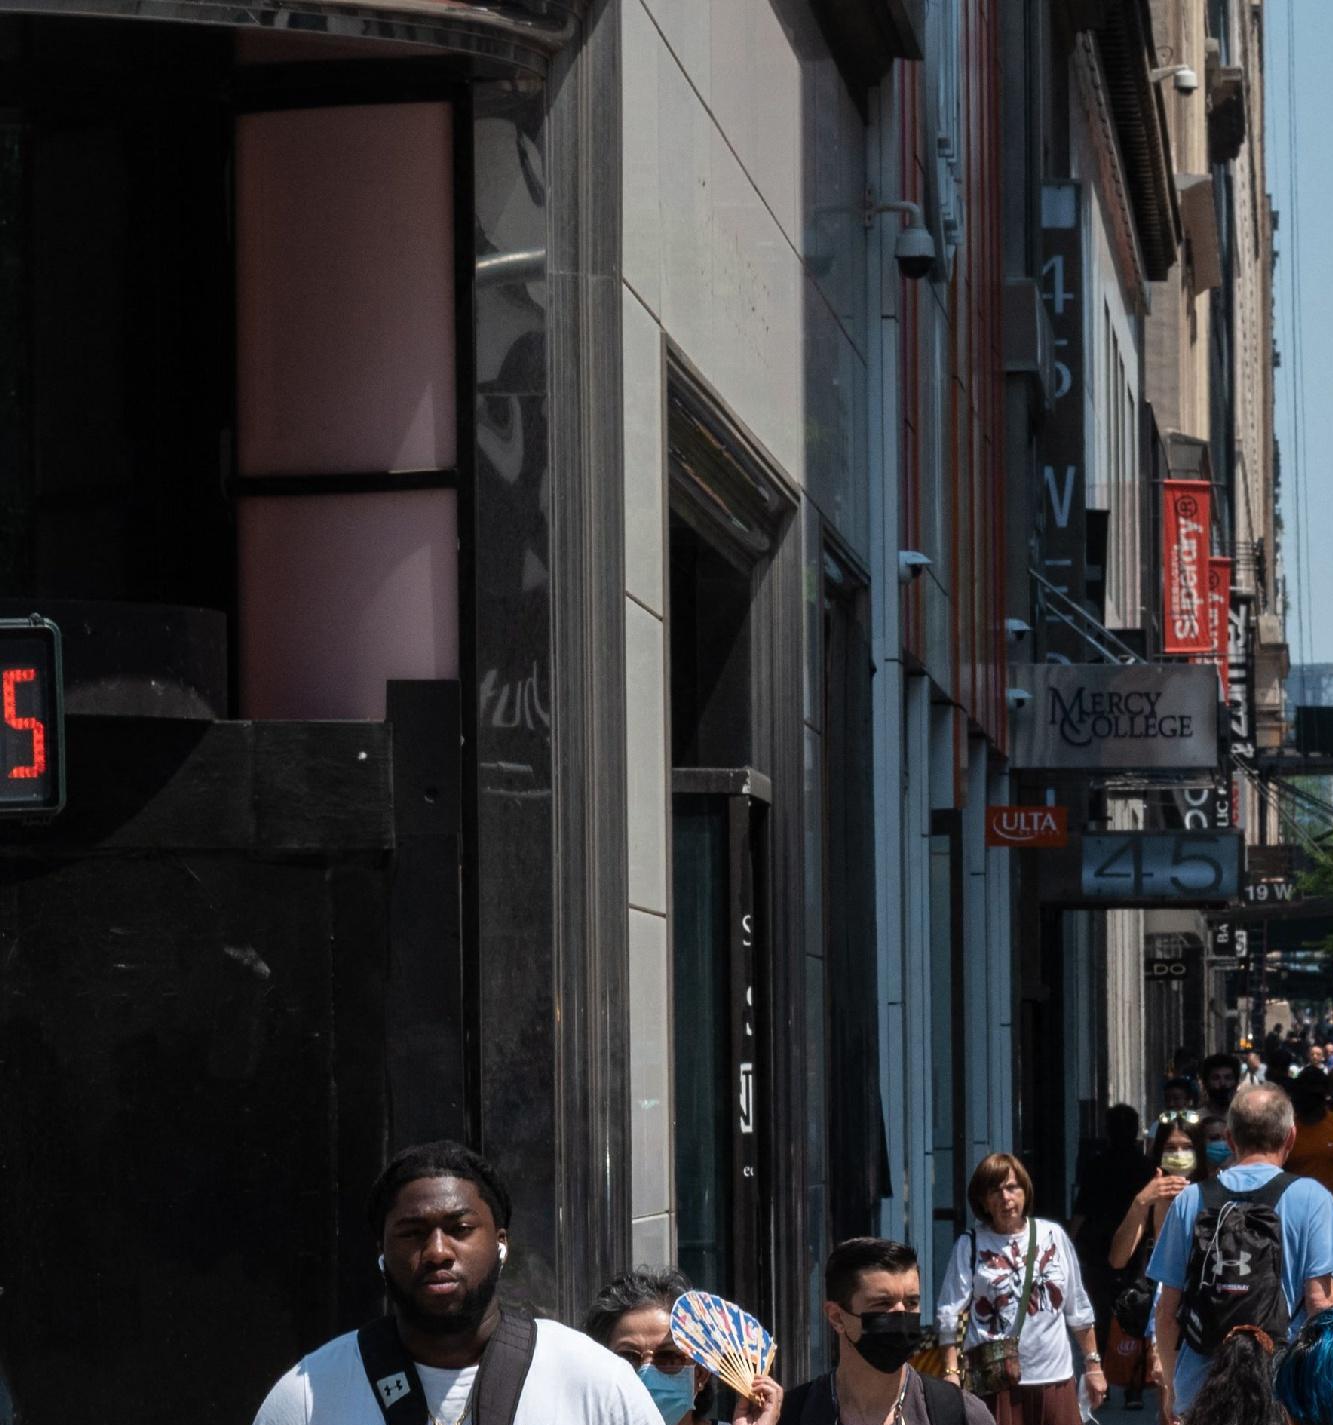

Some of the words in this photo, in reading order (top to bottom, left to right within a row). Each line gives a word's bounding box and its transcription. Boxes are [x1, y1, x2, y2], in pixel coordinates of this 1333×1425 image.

[2, 668, 46, 779] 5
[1050, 687, 1162, 725] MERCY
[1060, 715, 1193, 746] COLLEGE
[1002, 812, 1056, 831] ULTA
[1094, 837, 1223, 895] 45
